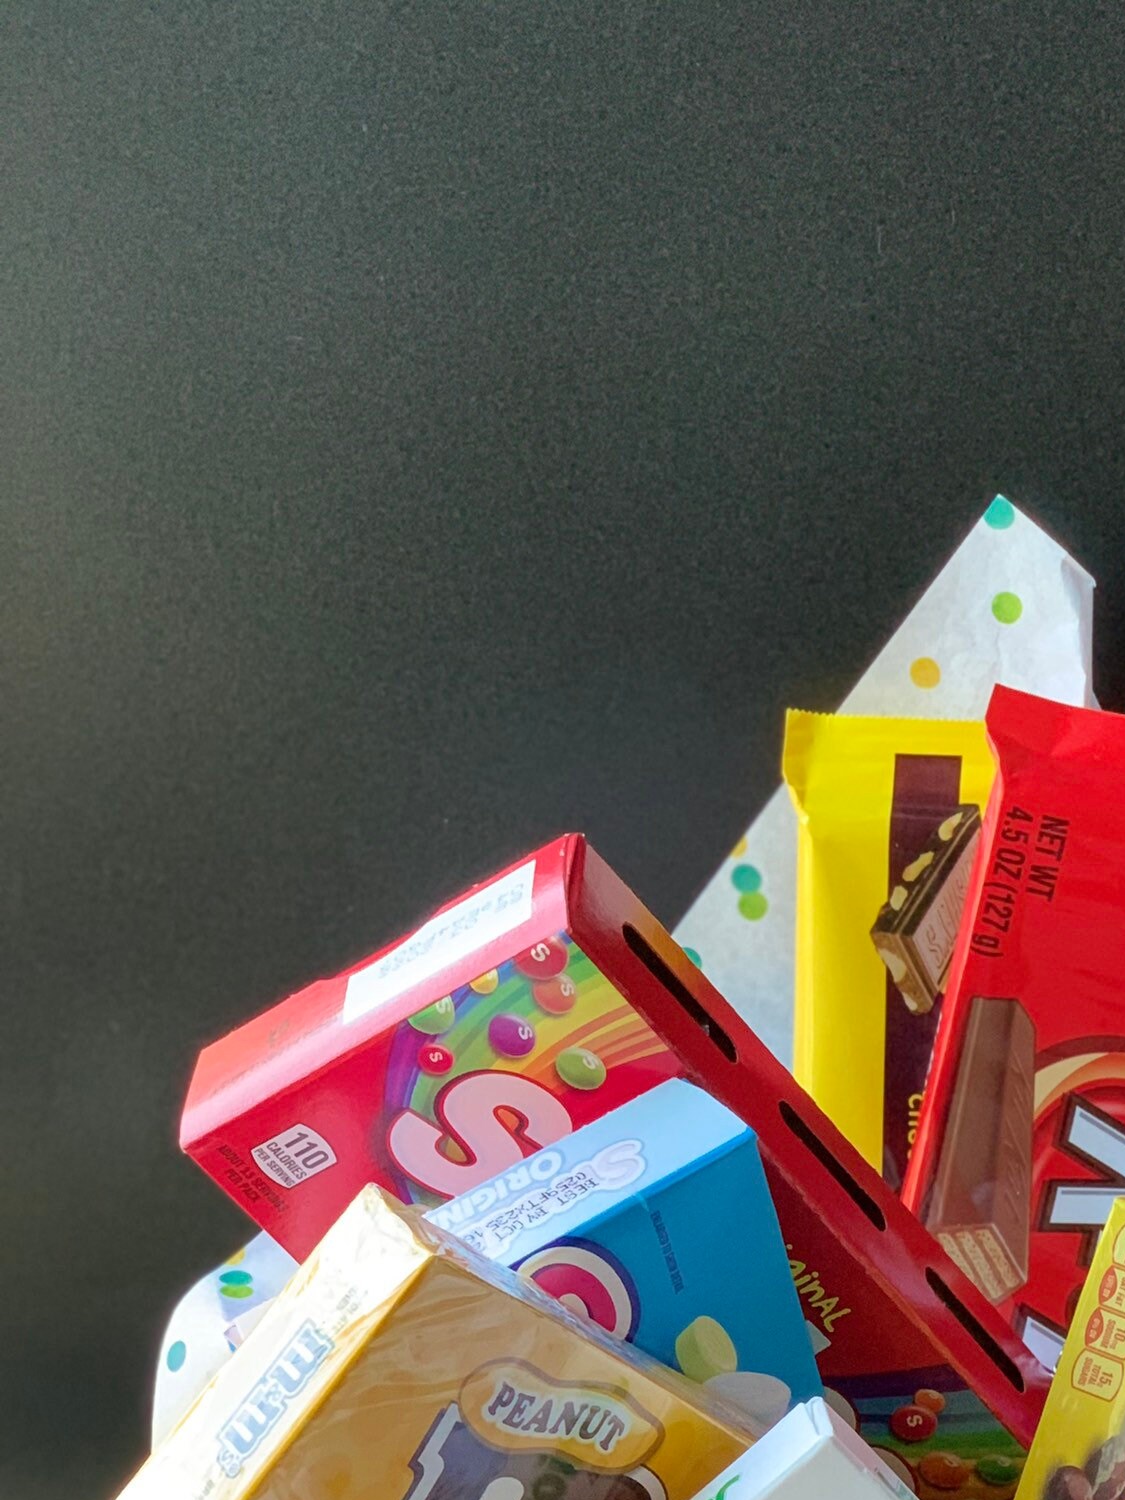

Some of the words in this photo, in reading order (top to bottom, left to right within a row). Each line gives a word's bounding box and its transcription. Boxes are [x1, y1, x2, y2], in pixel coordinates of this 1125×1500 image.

[1002, 805, 1034, 848] 4.5
[1038, 814, 1070, 860] NET
[993, 852, 1026, 880] OZ
[1026, 866, 1060, 901] WT
[980, 881, 1016, 935] (127
[970, 935, 1004, 958] g)
[254, 1148, 271, 1162] PER
[267, 1160, 296, 1187] SERVING
[266, 1142, 307, 1180] CALORIES
[285, 1132, 329, 1169] 110
[436, 1151, 562, 1229] ORIGIN
[558, 1178, 600, 1206] BEST
[495, 1220, 524, 1241] OCT
[528, 1207, 548, 1224] BY
[1114, 1294, 1125, 1307] FAT
[1088, 1364, 1102, 1385] TOTAL
[488, 1381, 627, 1451] PEANUT
